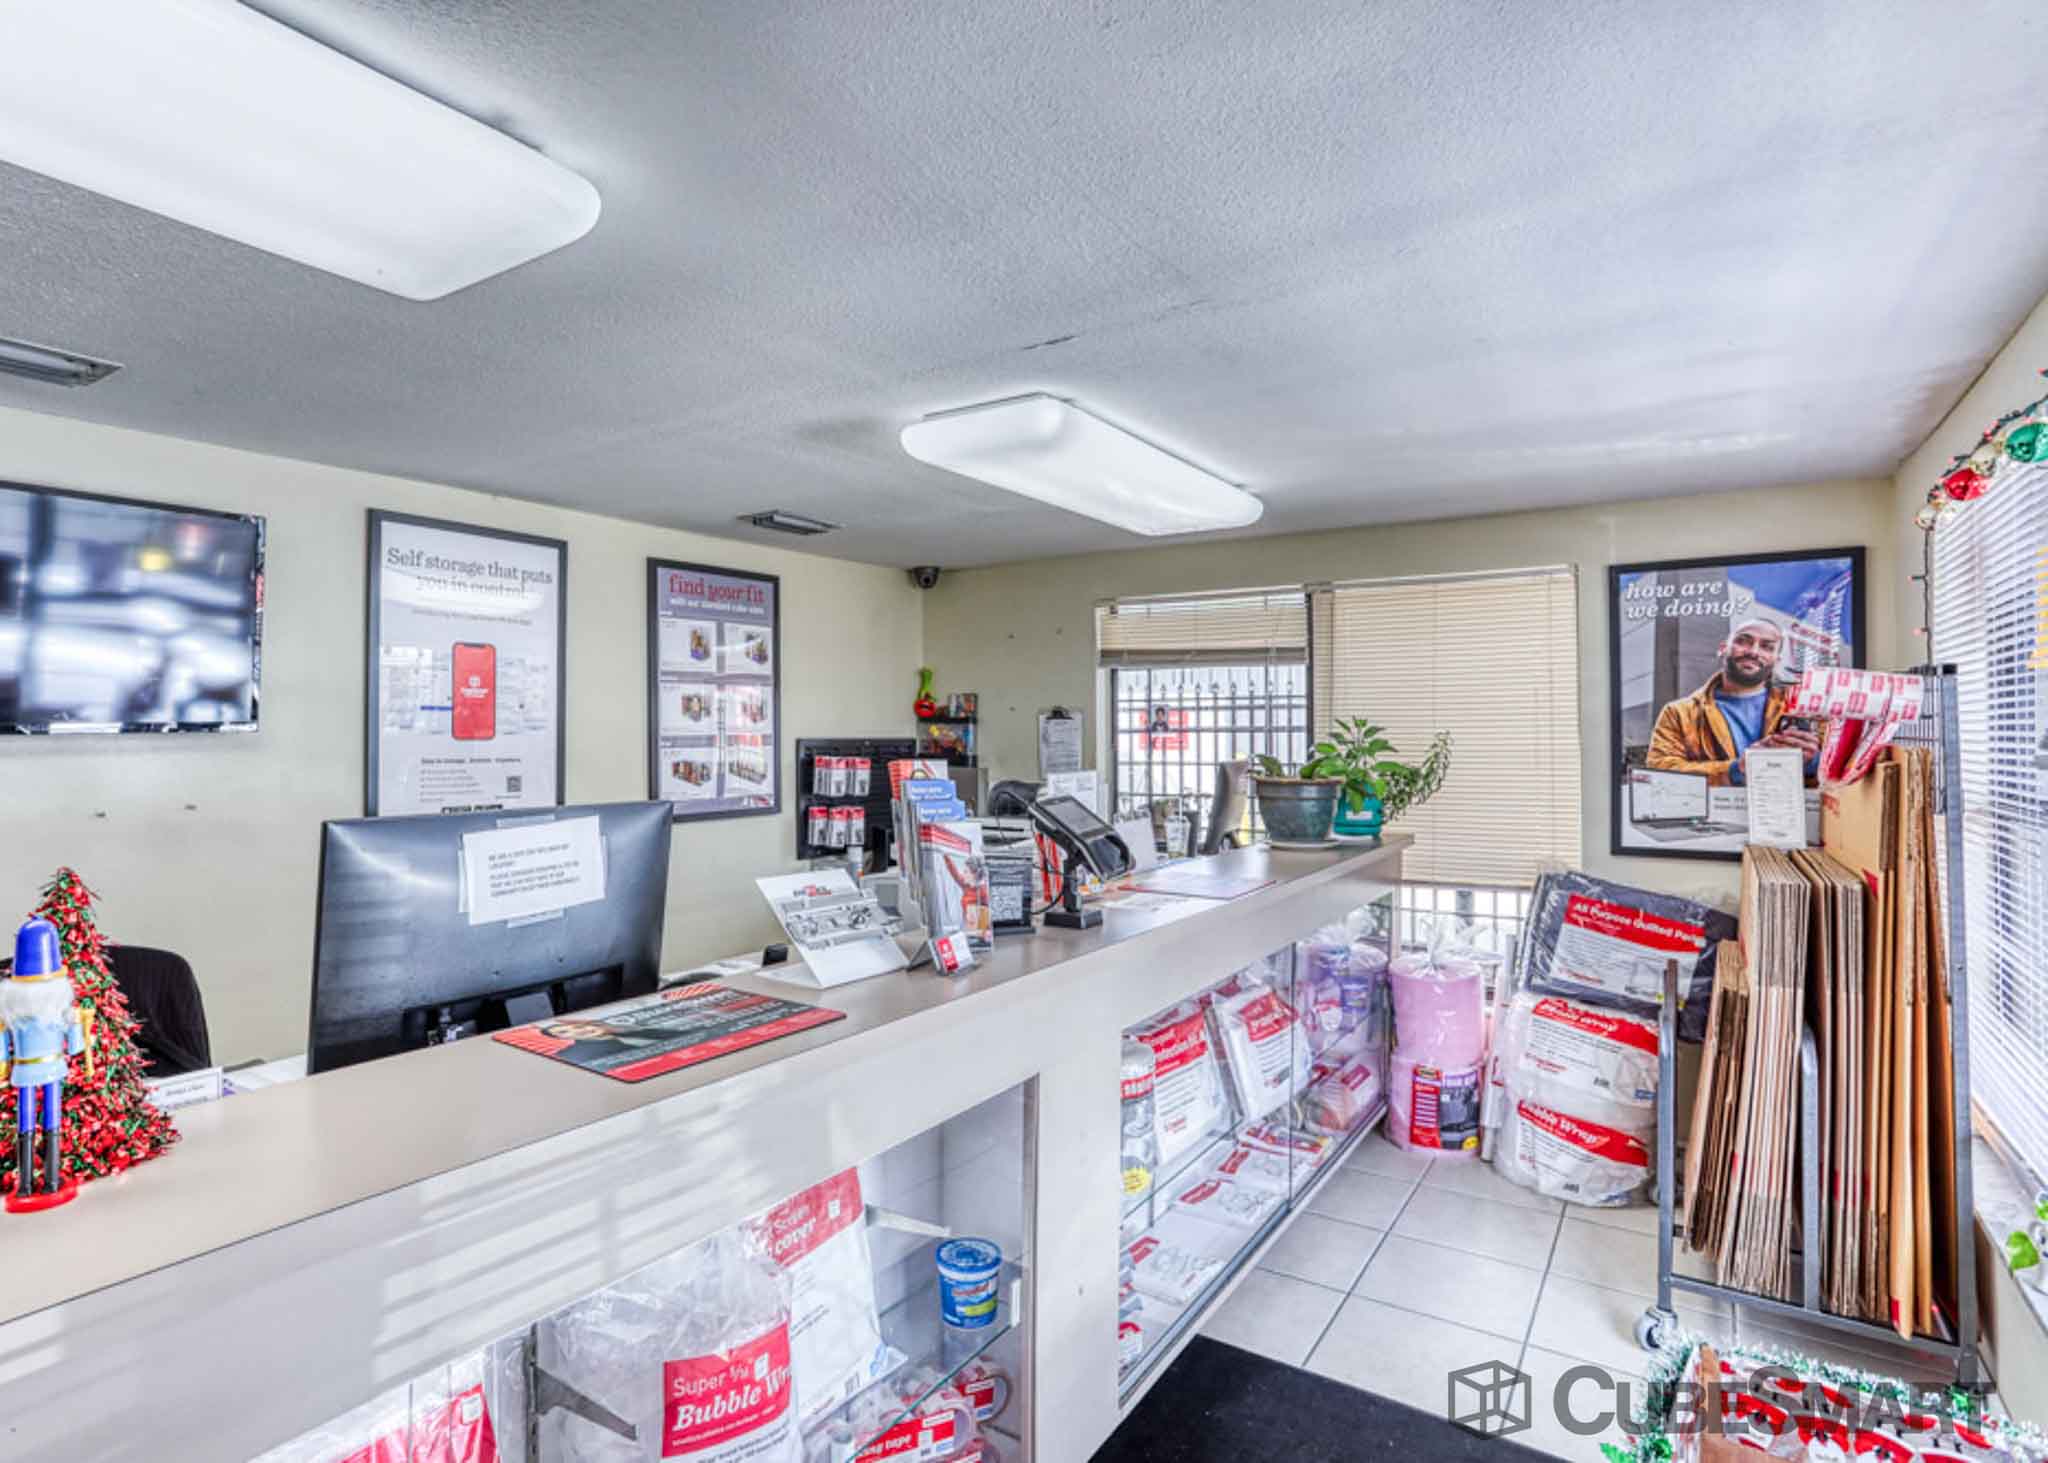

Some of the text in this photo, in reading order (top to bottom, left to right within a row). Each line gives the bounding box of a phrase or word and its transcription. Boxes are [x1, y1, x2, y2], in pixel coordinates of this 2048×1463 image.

[387, 547, 553, 585] Self storage that puts
[669, 572, 765, 603] find your fit
[1626, 581, 1722, 599] how are
[1627, 596, 1752, 619] we doing?
[1573, 903, 1588, 913] All
[1590, 905, 1632, 924] Purpose
[1633, 917, 1674, 937] Quilted
[776, 1216, 816, 1254] cover
[673, 1372, 726, 1397] Super
[672, 1384, 761, 1431] Bubble
